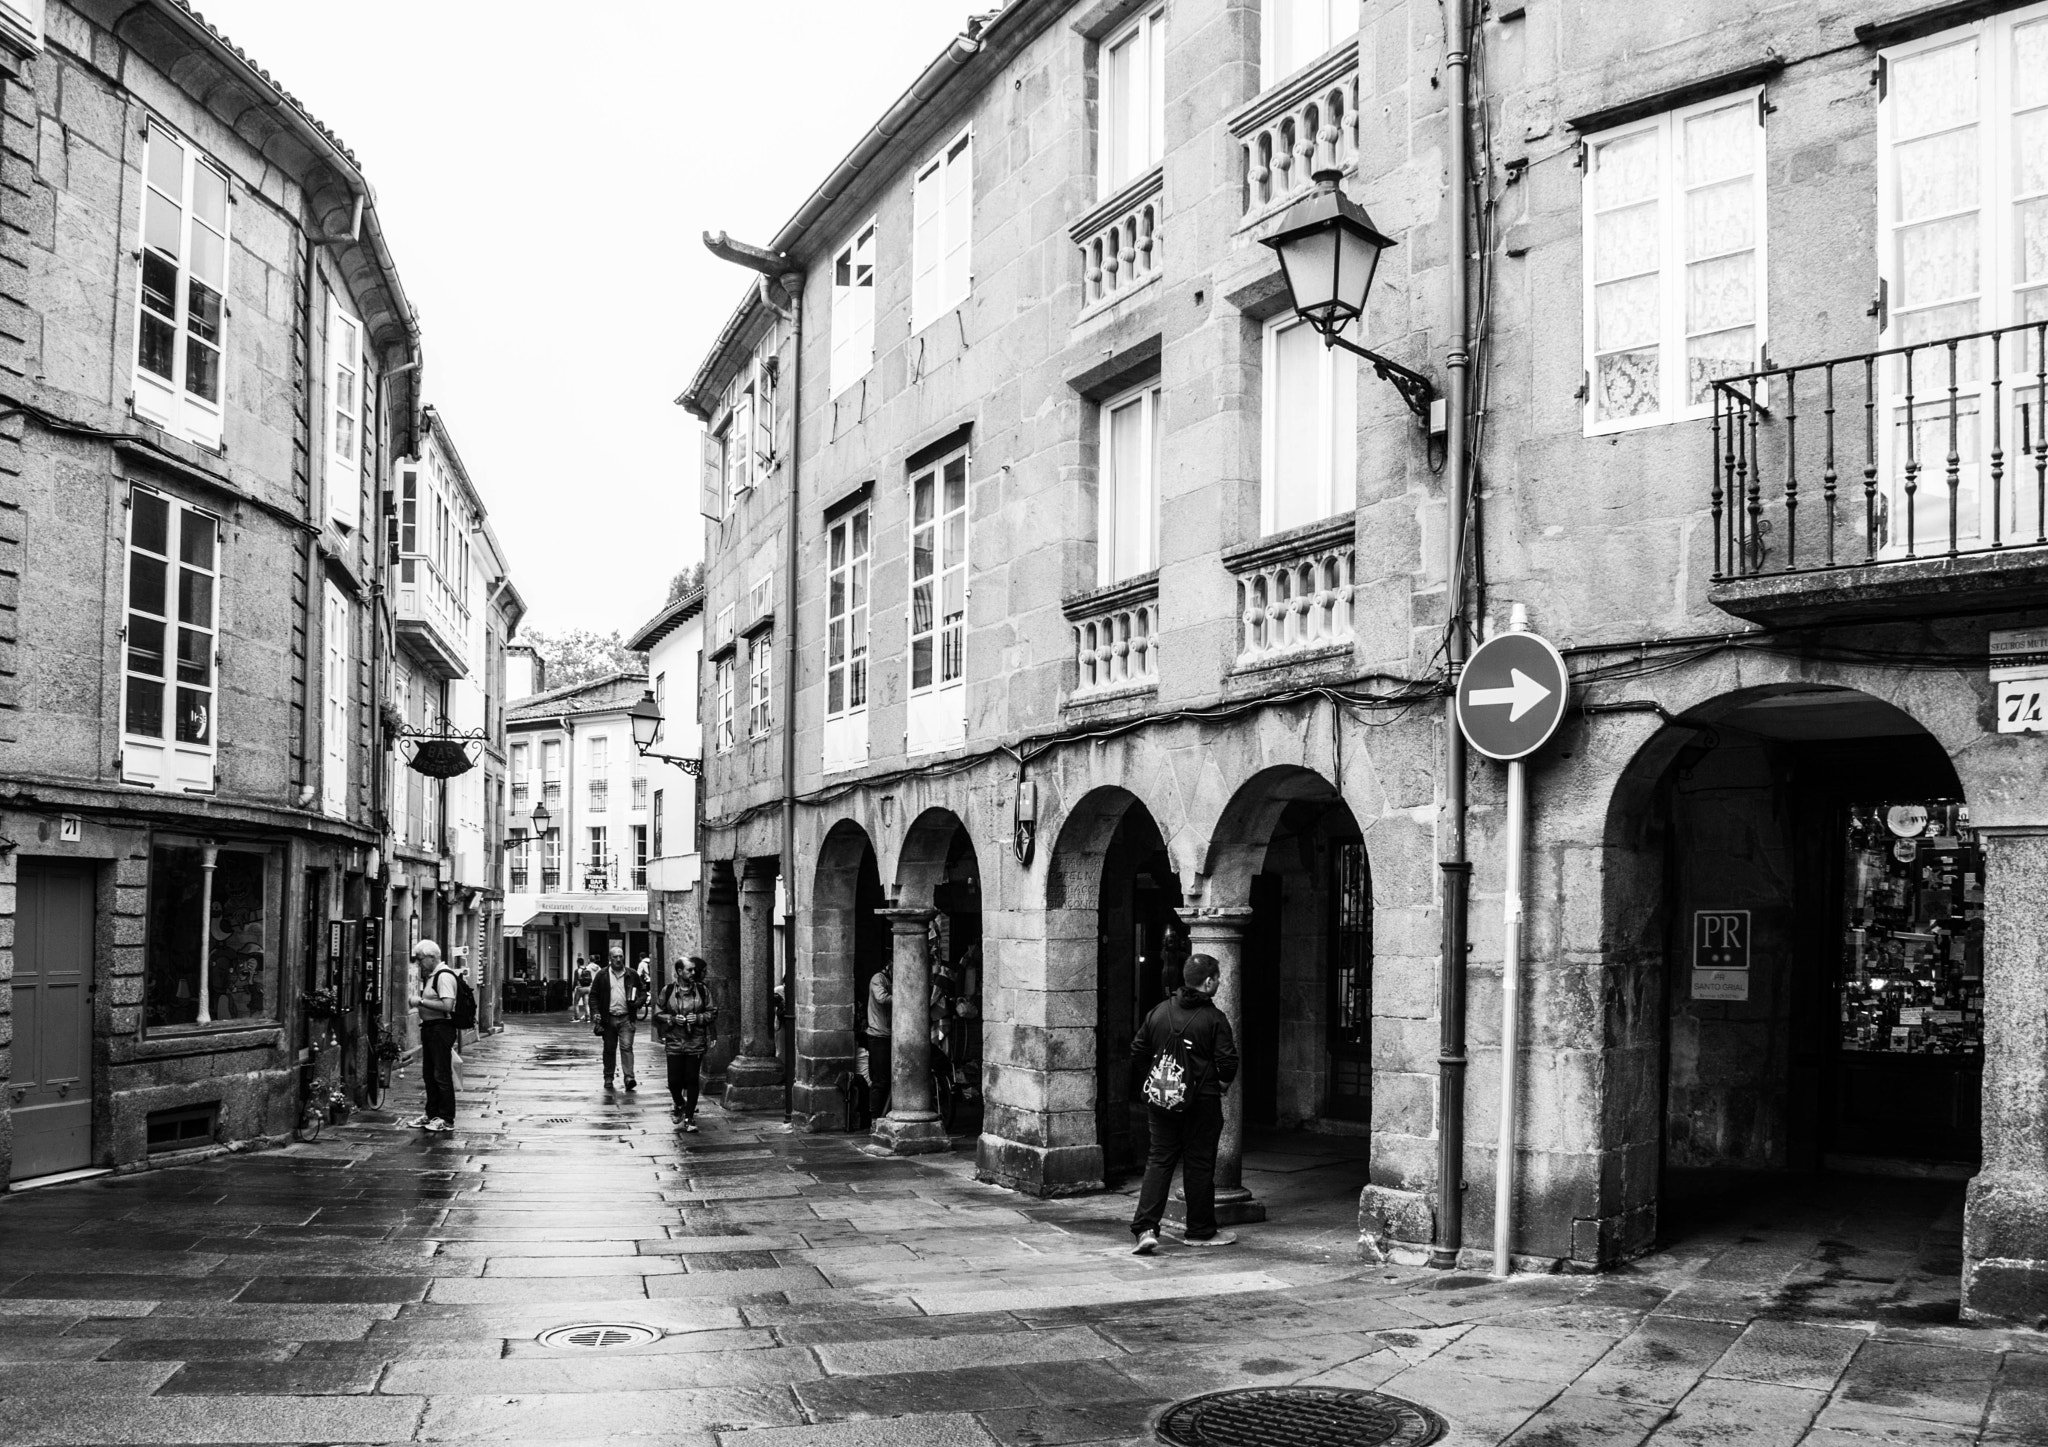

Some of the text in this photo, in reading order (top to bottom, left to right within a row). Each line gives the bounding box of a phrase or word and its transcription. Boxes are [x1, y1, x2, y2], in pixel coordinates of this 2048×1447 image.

[2005, 692, 2043, 722] 74
[427, 745, 456, 759] BAR
[65, 818, 77, 835] 71
[1701, 915, 1742, 948] PR
[1694, 983, 1721, 991] SANTO
